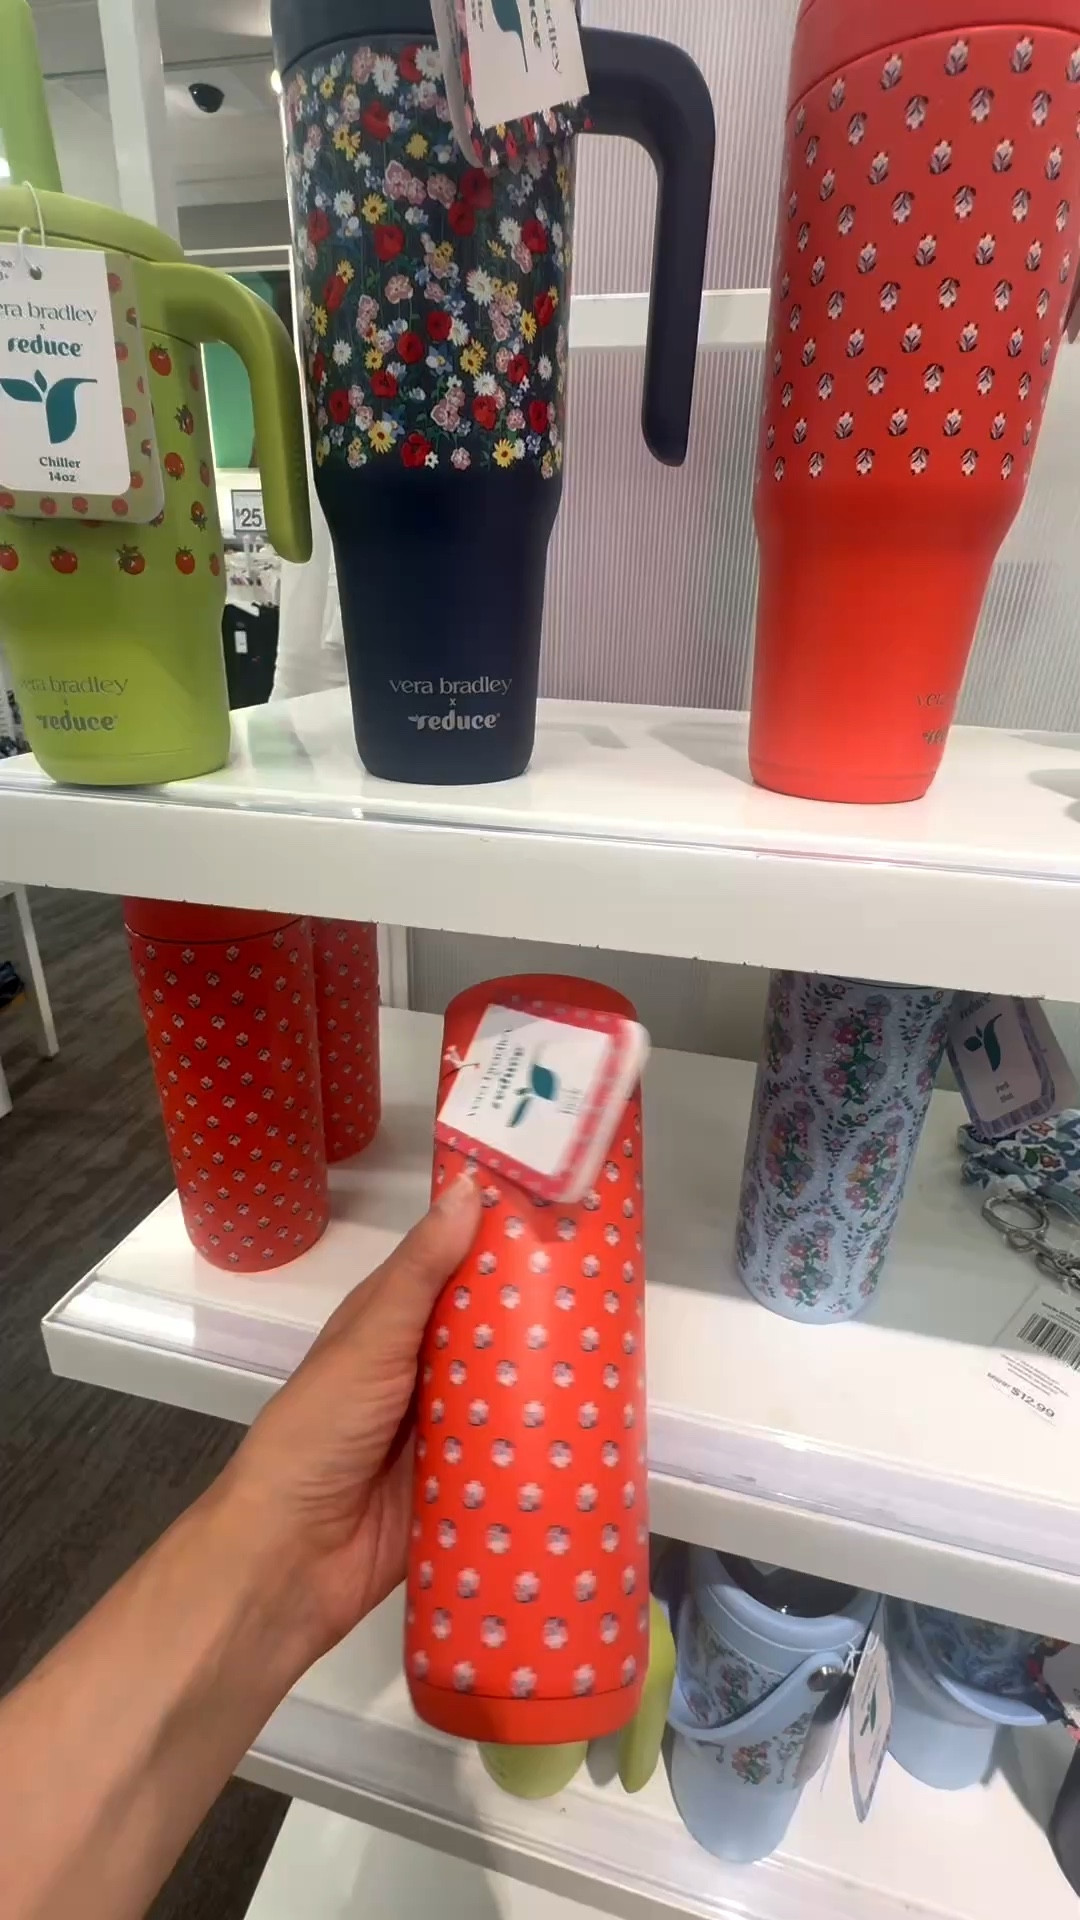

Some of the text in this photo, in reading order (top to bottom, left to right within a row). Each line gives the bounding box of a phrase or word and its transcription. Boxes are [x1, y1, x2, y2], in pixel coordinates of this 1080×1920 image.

[27, 301, 97, 326] bradley
[8, 334, 82, 357] reduce
[39, 455, 81, 468] Chiller
[49, 471, 77, 482] 14oz
[48, 675, 129, 696] bradley
[389, 676, 513, 695] vera bradley
[449, 697, 457, 706] x
[36, 709, 114, 731] reduce
[407, 709, 498, 730] reduce
